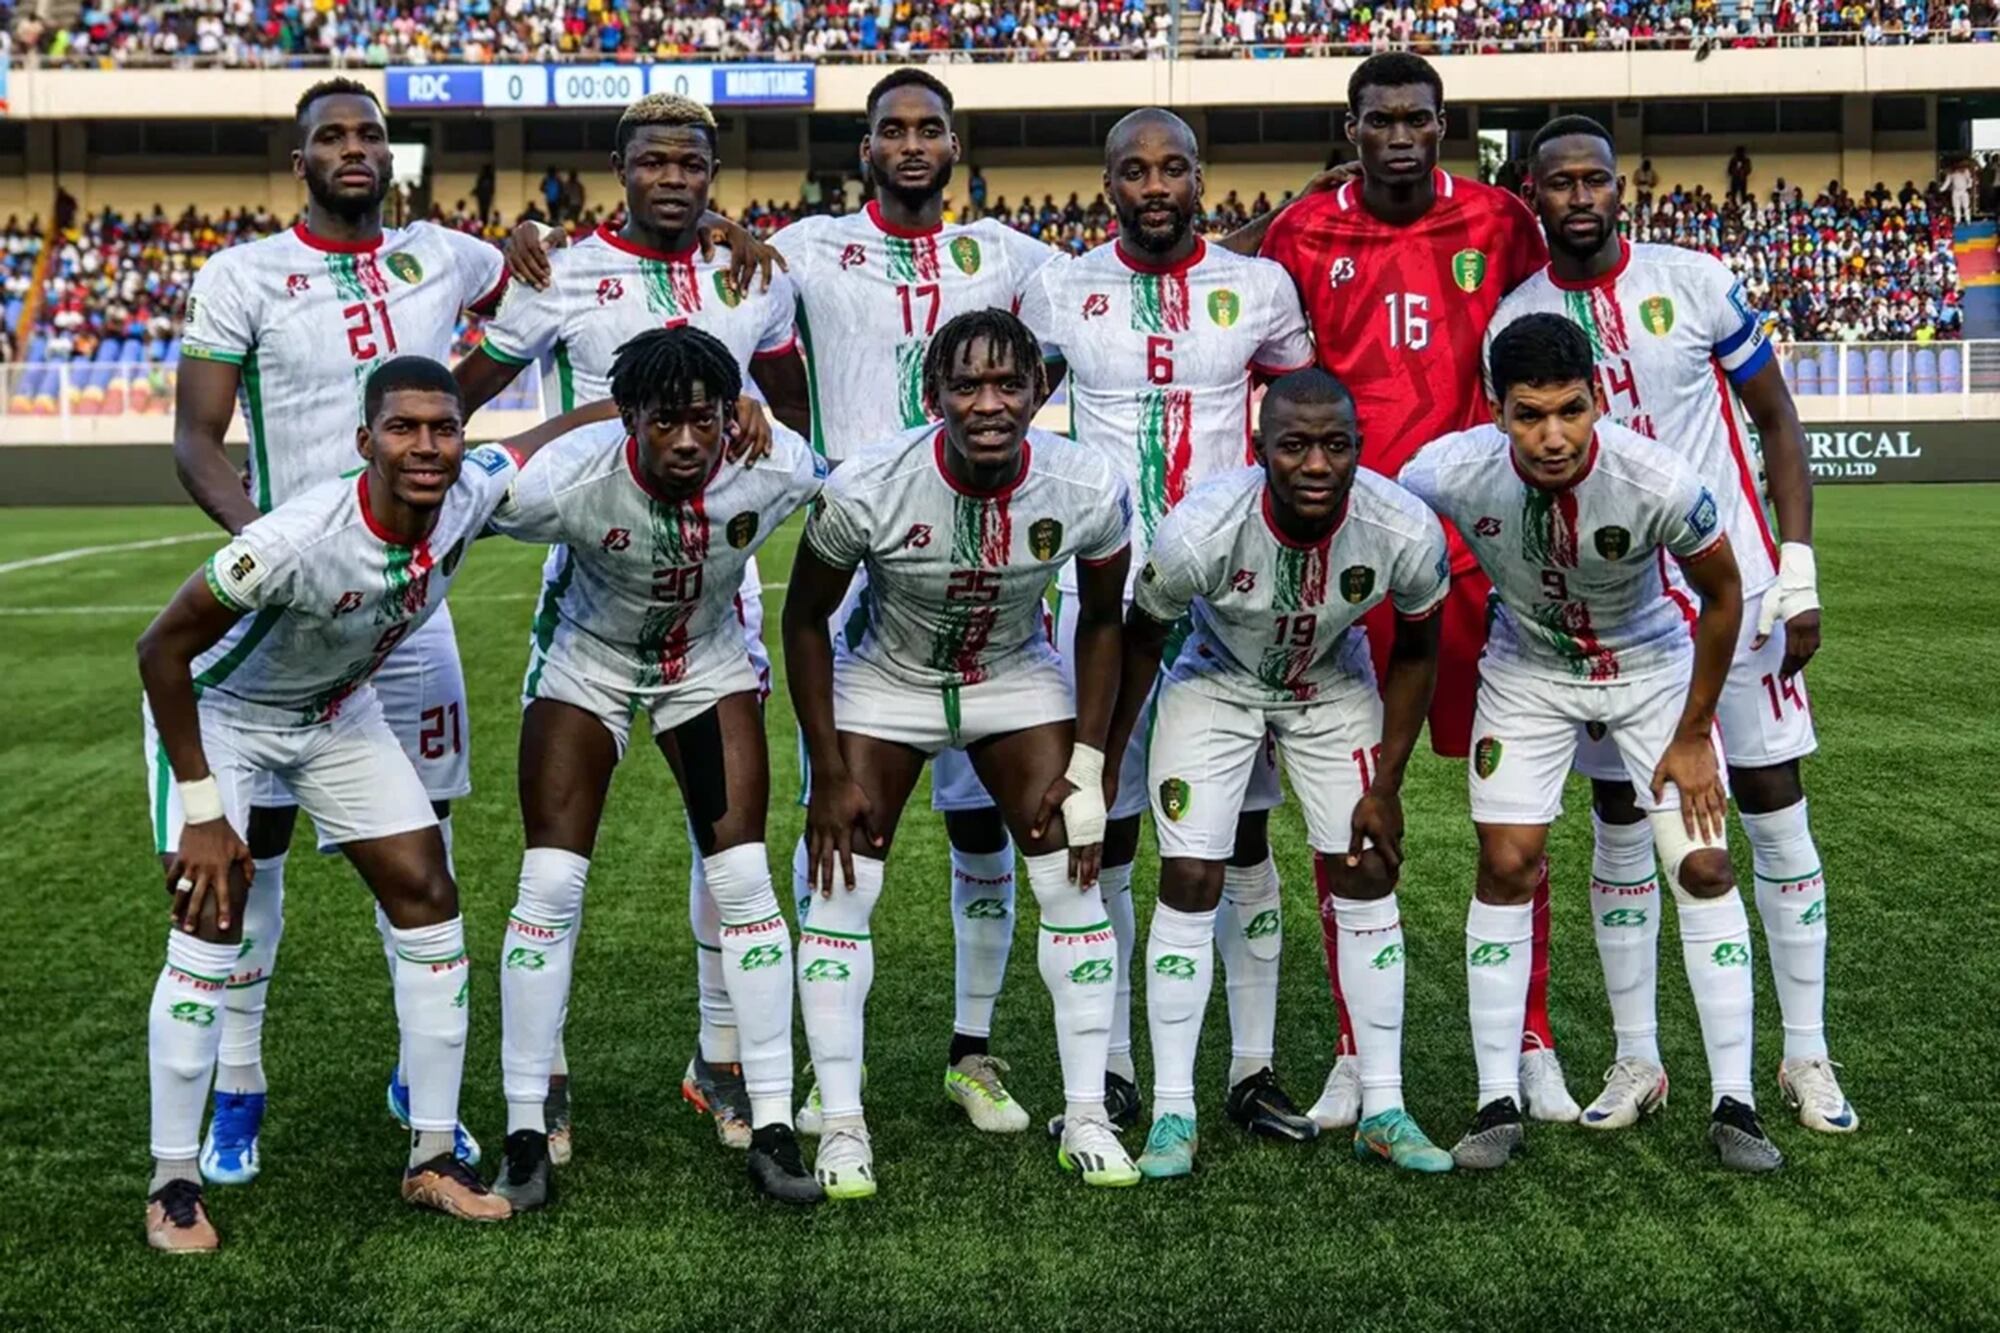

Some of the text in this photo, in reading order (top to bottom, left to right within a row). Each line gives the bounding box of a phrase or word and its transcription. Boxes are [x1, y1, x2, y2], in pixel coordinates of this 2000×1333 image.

[408, 75, 451, 101] RDC
[508, 75, 523, 100] 0
[567, 75, 630, 99] 00:00
[674, 75, 689, 95] 0
[896, 283, 941, 337] 17
[1384, 292, 1430, 350] 16
[343, 299, 398, 360] 21
[1147, 335, 1174, 386] 6
[1804, 431, 1921, 458] RICAL
[1846, 462, 1877, 475] LTD
[653, 563, 703, 603] 20
[946, 569, 1002, 601] 25
[1541, 569, 1568, 600] 9
[1273, 613, 1317, 647] 19
[420, 700, 462, 760] 21
